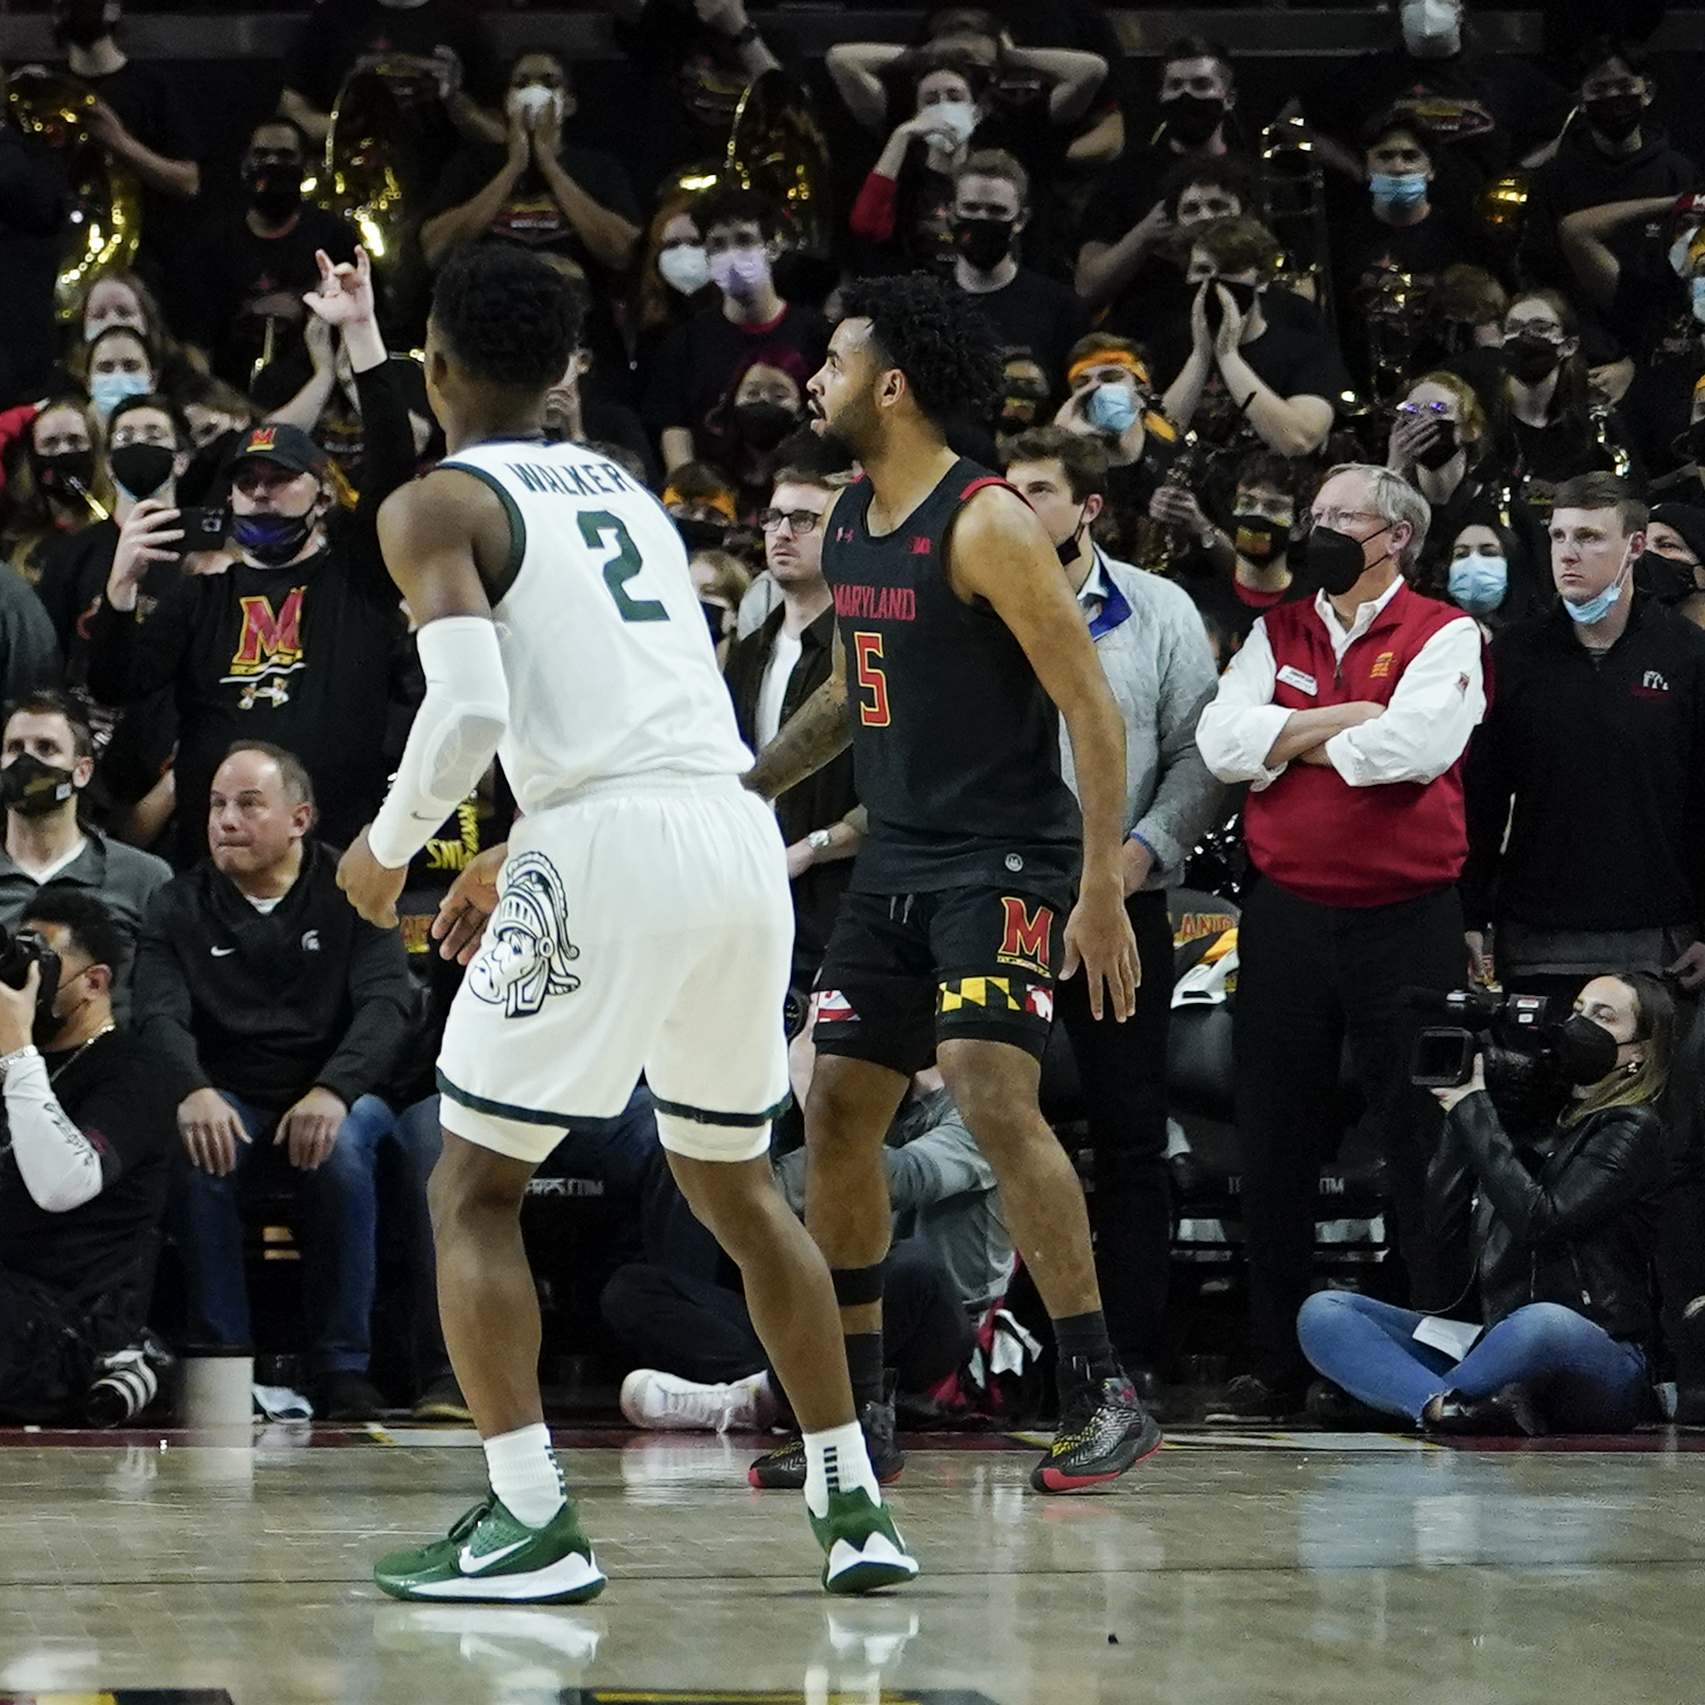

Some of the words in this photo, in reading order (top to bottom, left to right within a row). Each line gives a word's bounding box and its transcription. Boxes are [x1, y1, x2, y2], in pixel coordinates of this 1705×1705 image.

[504, 462, 638, 495] WALKER
[576, 510, 671, 623] 2
[833, 583, 916, 622] MARYLAND
[853, 630, 892, 728] 5
[997, 896, 1055, 970] M
